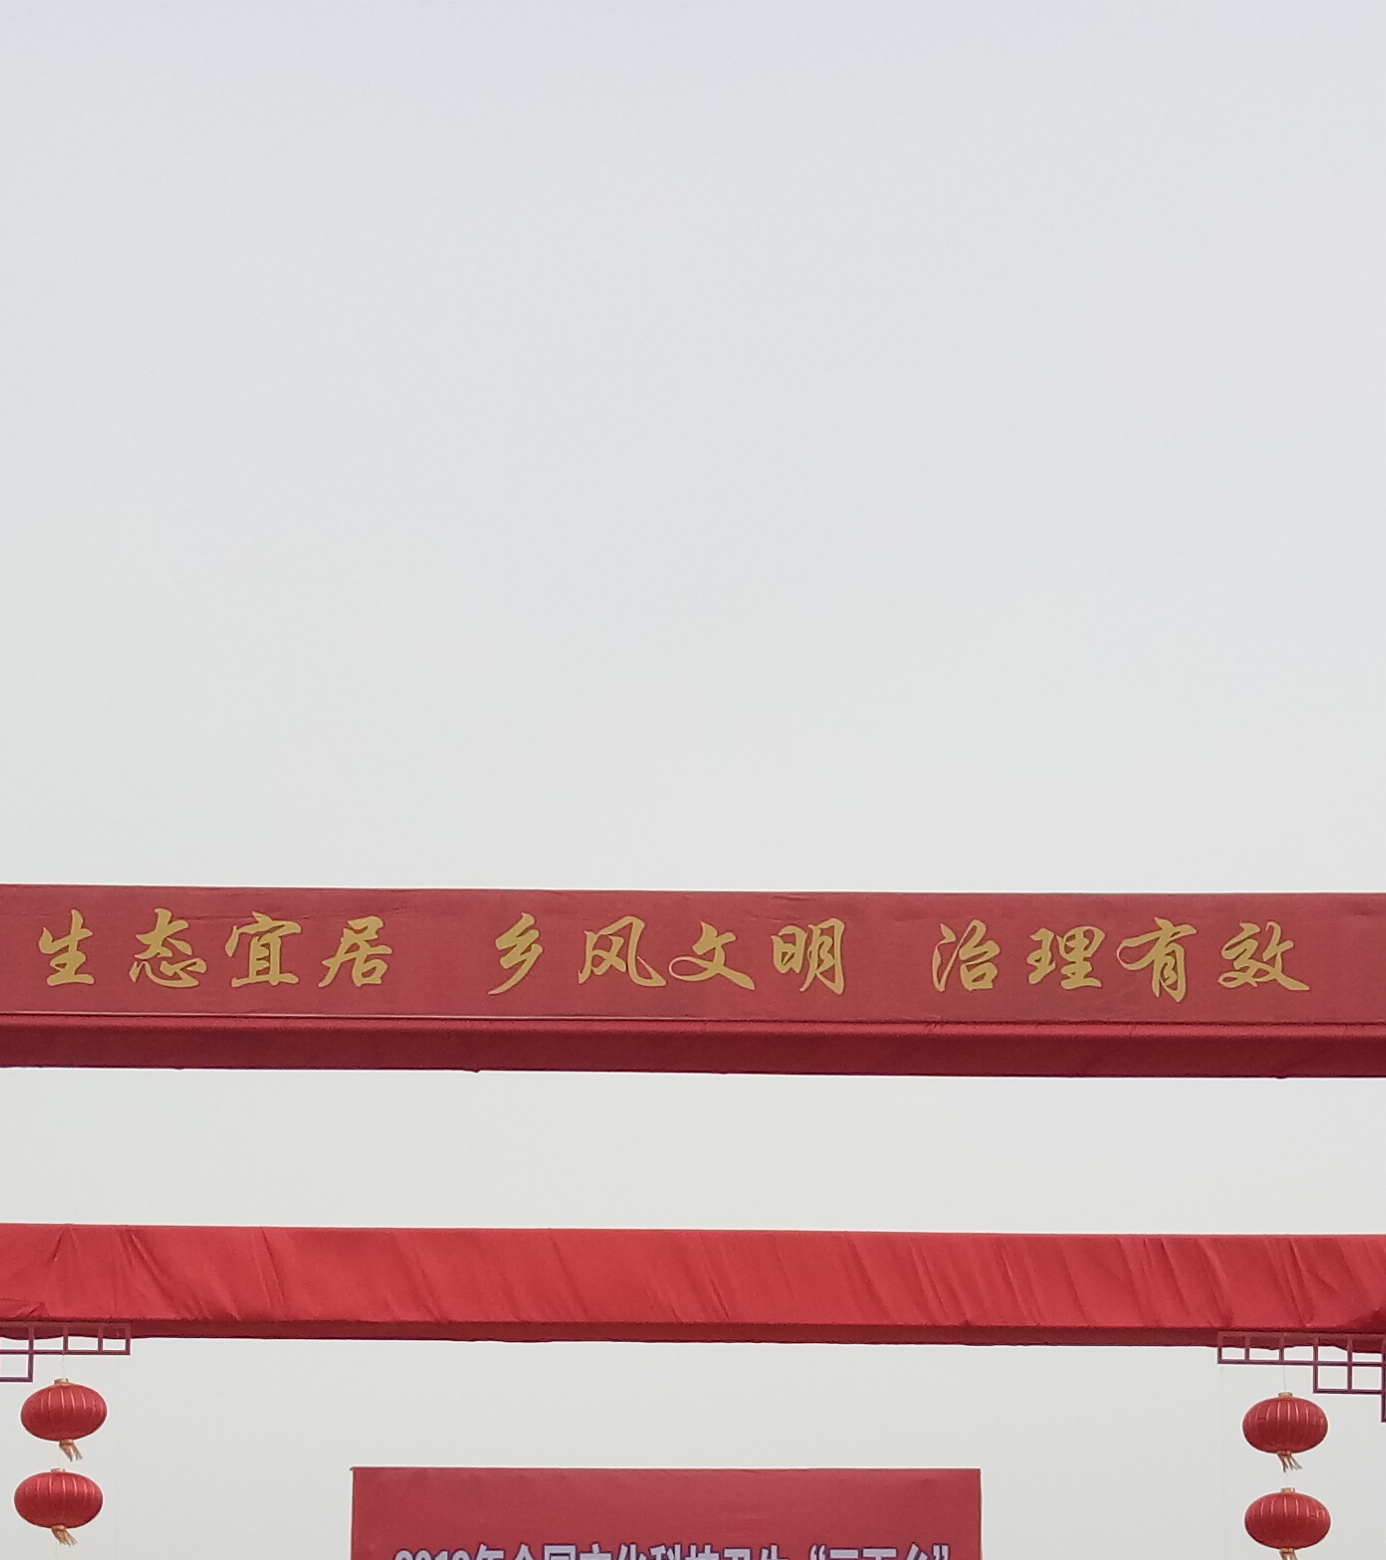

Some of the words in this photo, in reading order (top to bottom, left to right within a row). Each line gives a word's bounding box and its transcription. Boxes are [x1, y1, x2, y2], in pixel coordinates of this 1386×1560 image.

[37, 908, 394, 988] 生态宜居
[488, 912, 846, 995] 乡风文明
[930, 916, 1310, 1000] 治理有效
